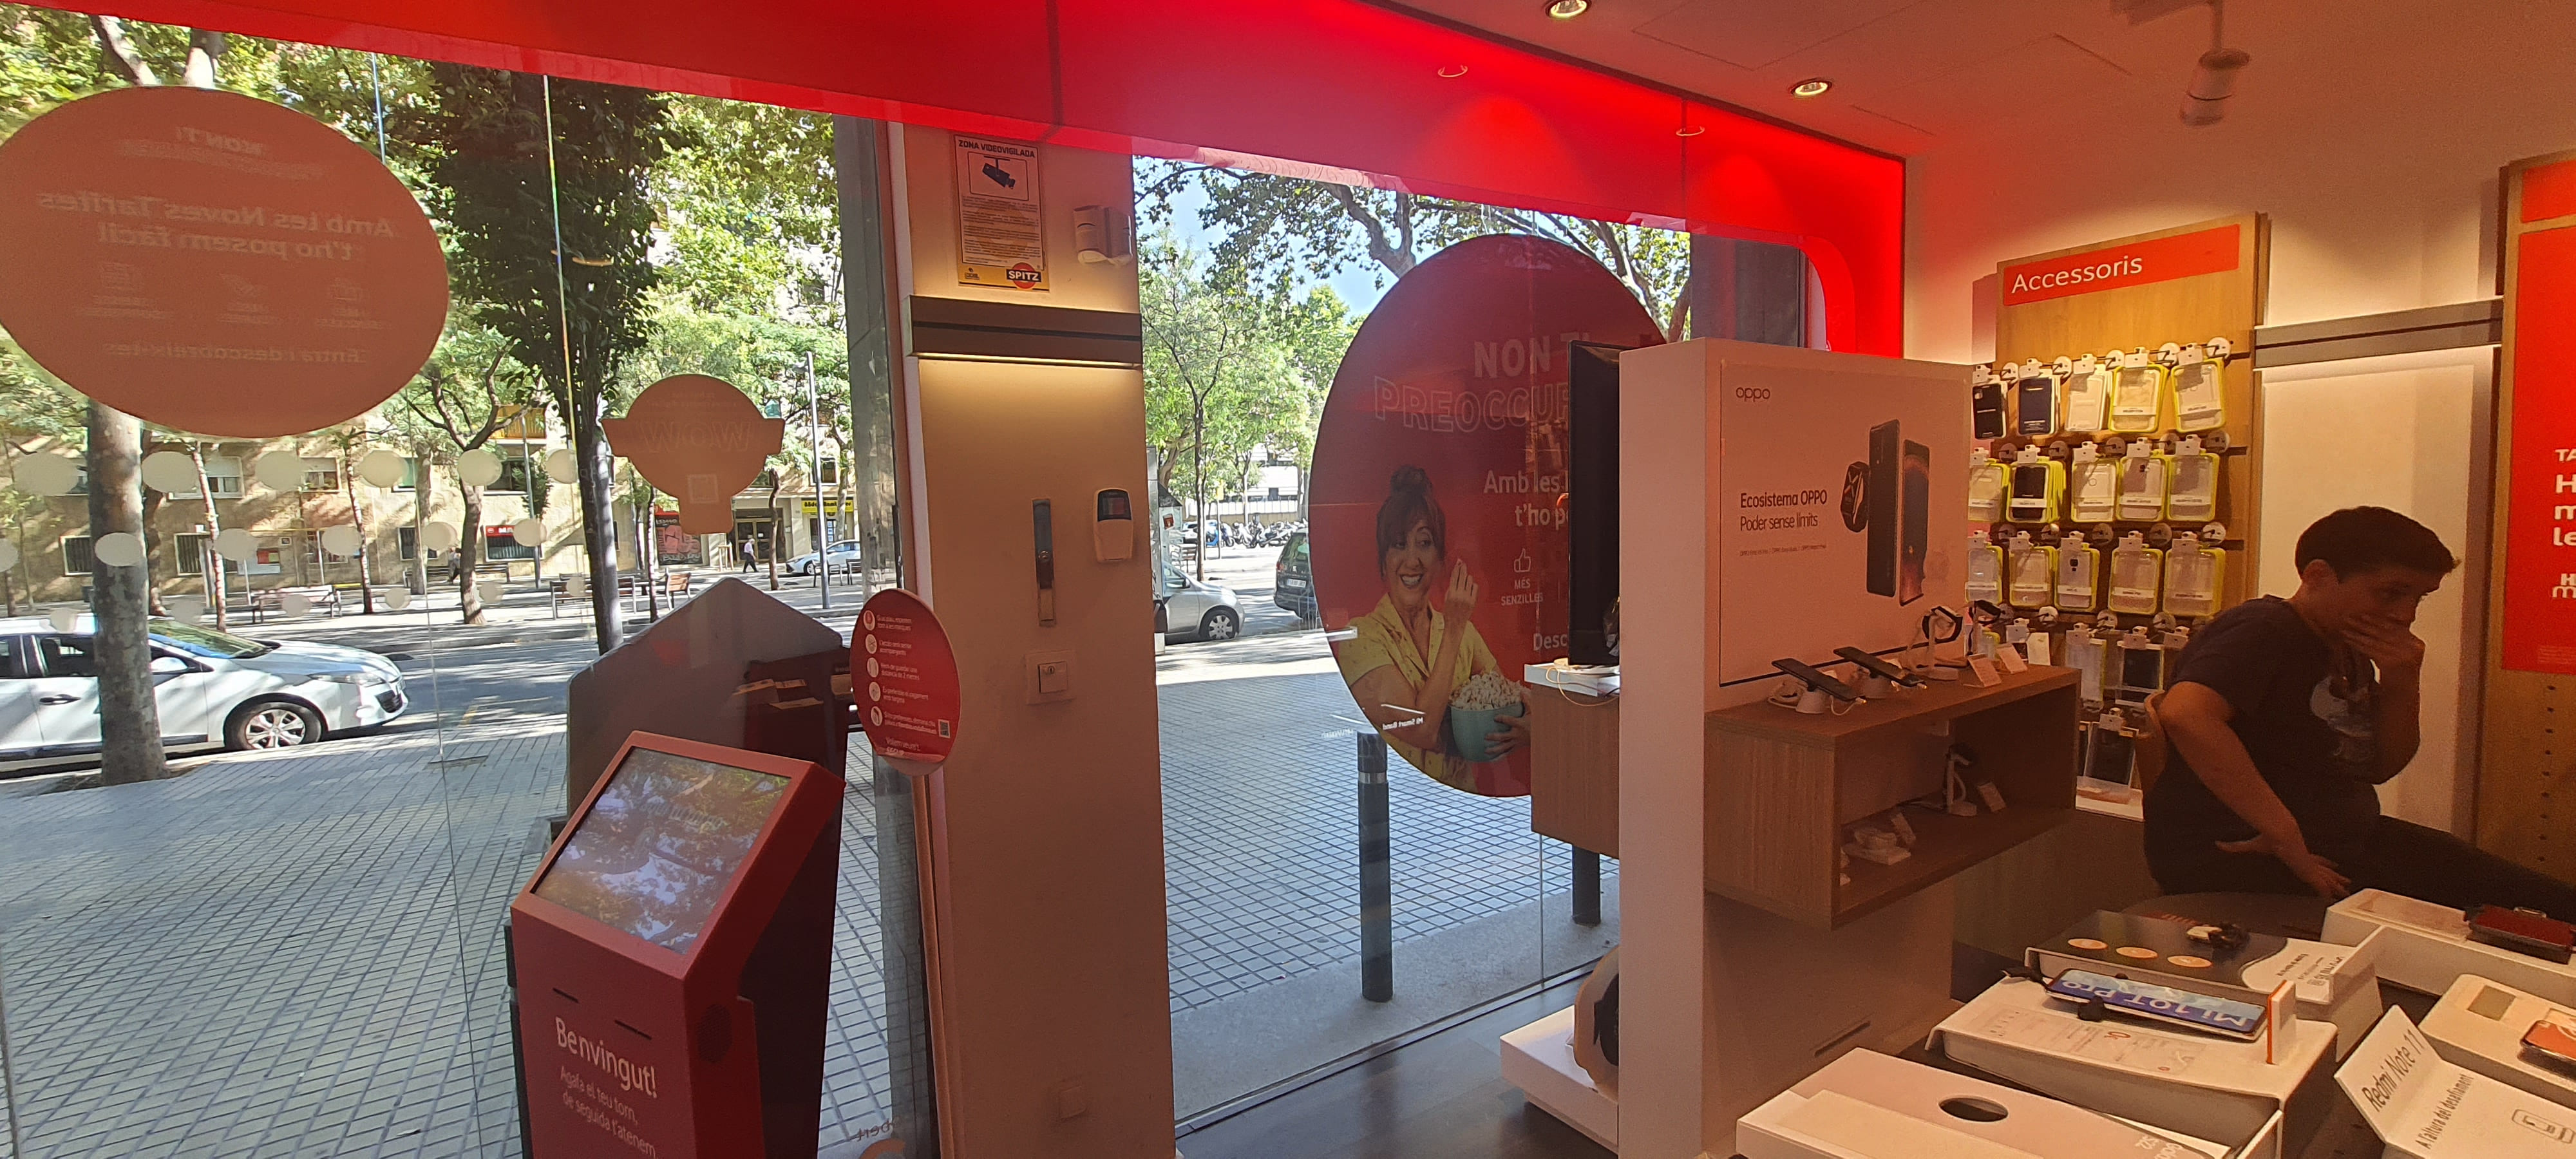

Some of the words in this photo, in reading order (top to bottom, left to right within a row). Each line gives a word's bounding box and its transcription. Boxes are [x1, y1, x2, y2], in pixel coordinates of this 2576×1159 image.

[958, 139, 980, 150] ZONA
[980, 143, 1036, 158] VIDEOVIGILADA
[1008, 270, 1039, 281] SPITZ
[2011, 255, 2143, 294] Accessoris
[1473, 335, 1551, 379] NON
[1483, 469, 1530, 494] Amb
[1533, 470, 1560, 494] les
[1740, 491, 1799, 509] Ecosistema
[1801, 489, 1828, 506] OPPO
[1514, 502, 1551, 527] t'ho
[1740, 514, 1767, 531] Poder
[1769, 516, 1795, 530] sense
[1514, 576, 1531, 590] MÉS
[1501, 592, 1544, 607] SENZILLES
[2062, 980, 2120, 999] Pro
[2124, 992, 2190, 1014] 10T
[2202, 1008, 2249, 1027] Mi
[555, 1016, 658, 1099] Benvingut!
[2362, 1065, 2398, 1113] Redmi
[2385, 1046, 2416, 1082] Note
[2404, 1028, 2425, 1055] 11
[560, 1066, 585, 1092] Agafa
[587, 1081, 596, 1100] el
[596, 1087, 614, 1109] teu
[613, 1098, 639, 1126] torn,
[2439, 1072, 2475, 1110] desafiament
[563, 1089, 574, 1109] de
[575, 1099, 611, 1131] seguida
[2432, 1106, 2453, 1120] del
[2415, 1139, 2432, 1150] A
